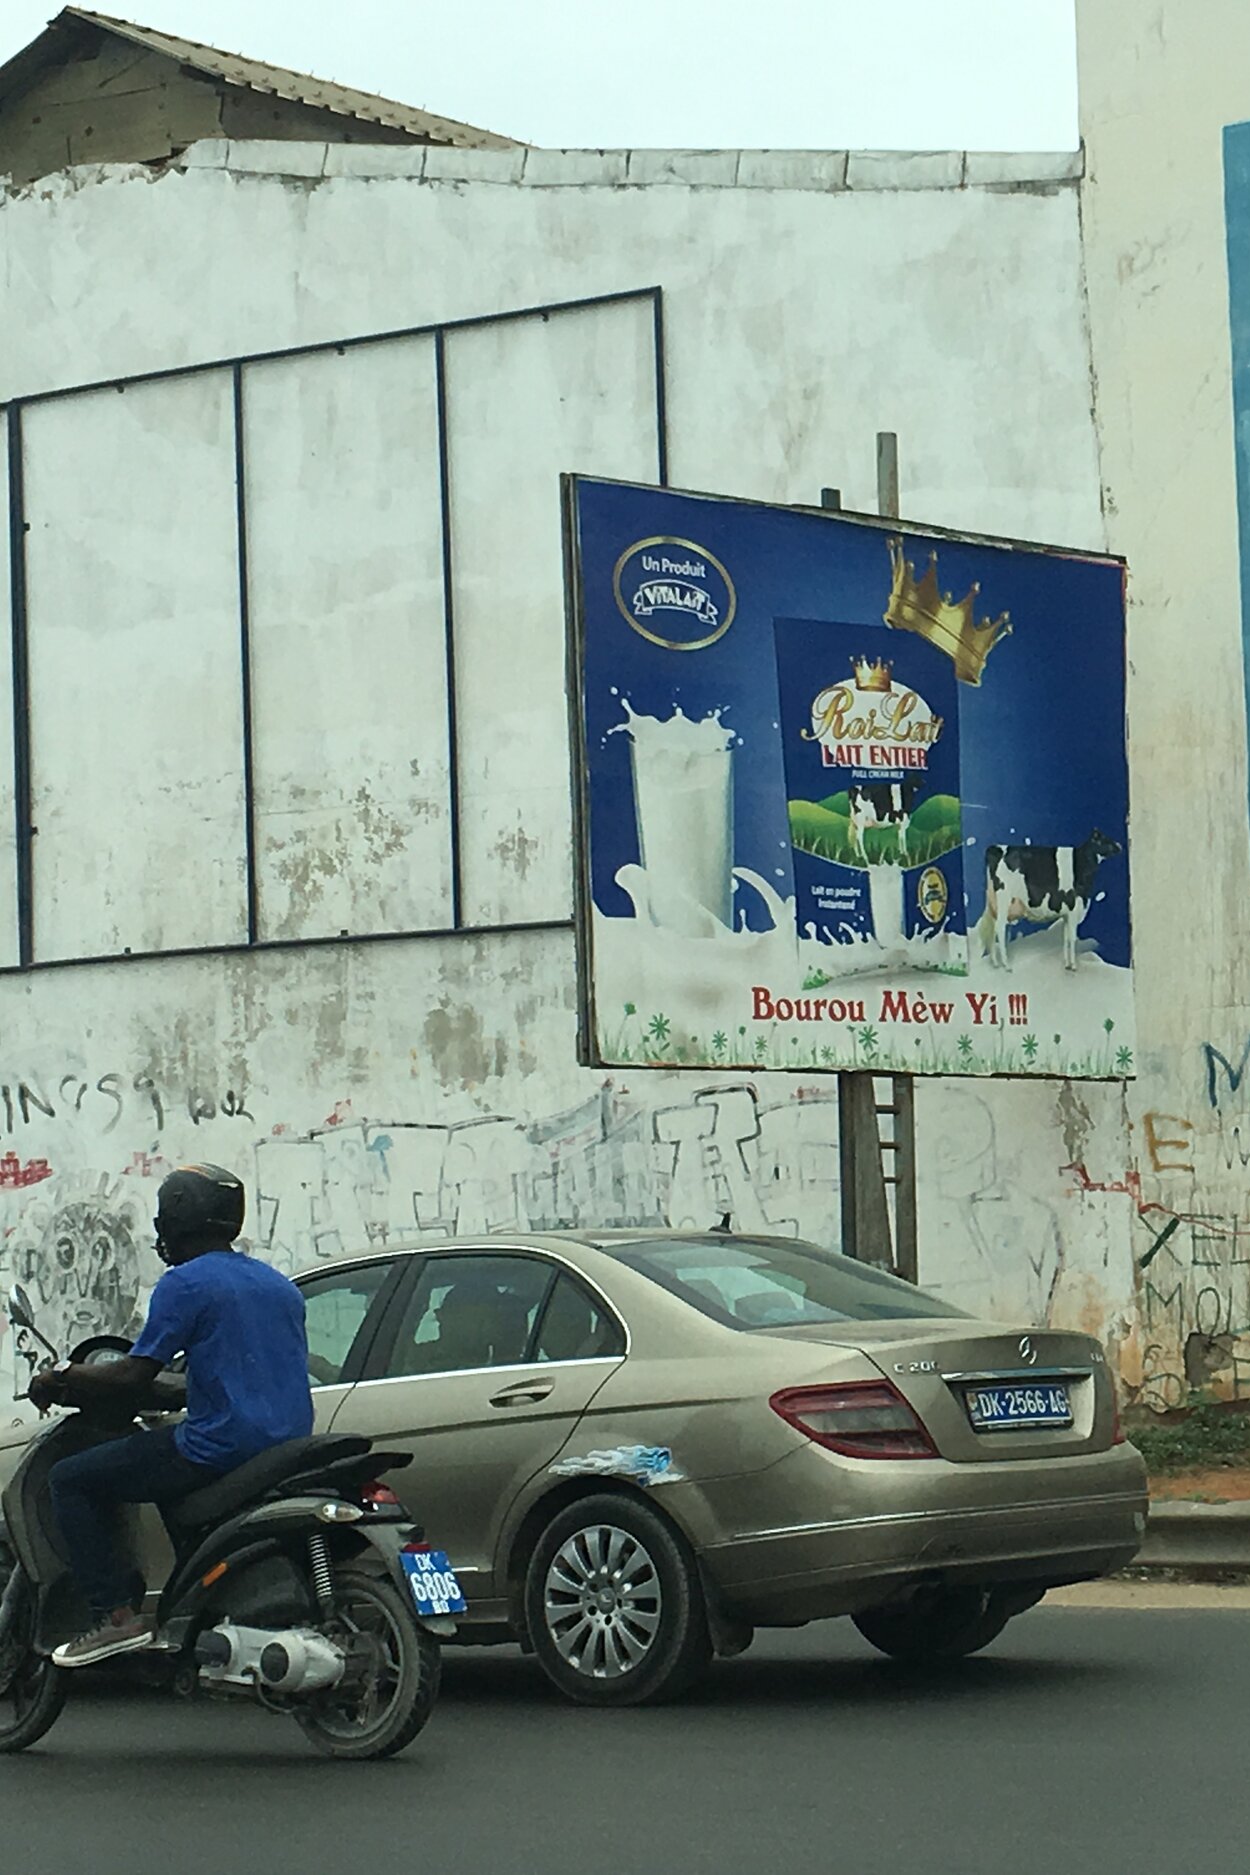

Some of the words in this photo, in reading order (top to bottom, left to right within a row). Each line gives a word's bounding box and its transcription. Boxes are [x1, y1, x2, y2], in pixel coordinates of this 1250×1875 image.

[642, 555, 660, 572] Un
[661, 558, 706, 578] Produit
[800, 686, 876, 742] Roi
[872, 692, 945, 744] Lait
[823, 744, 863, 767] LAIT
[869, 745, 929, 768] ENTIER
[751, 986, 867, 1022] Bourou
[878, 990, 955, 1024] Mèw
[965, 993, 999, 1025] Yi
[1008, 994, 1028, 1025] !!!
[414, 1552, 436, 1571] DK
[410, 1571, 461, 1602] 6806
